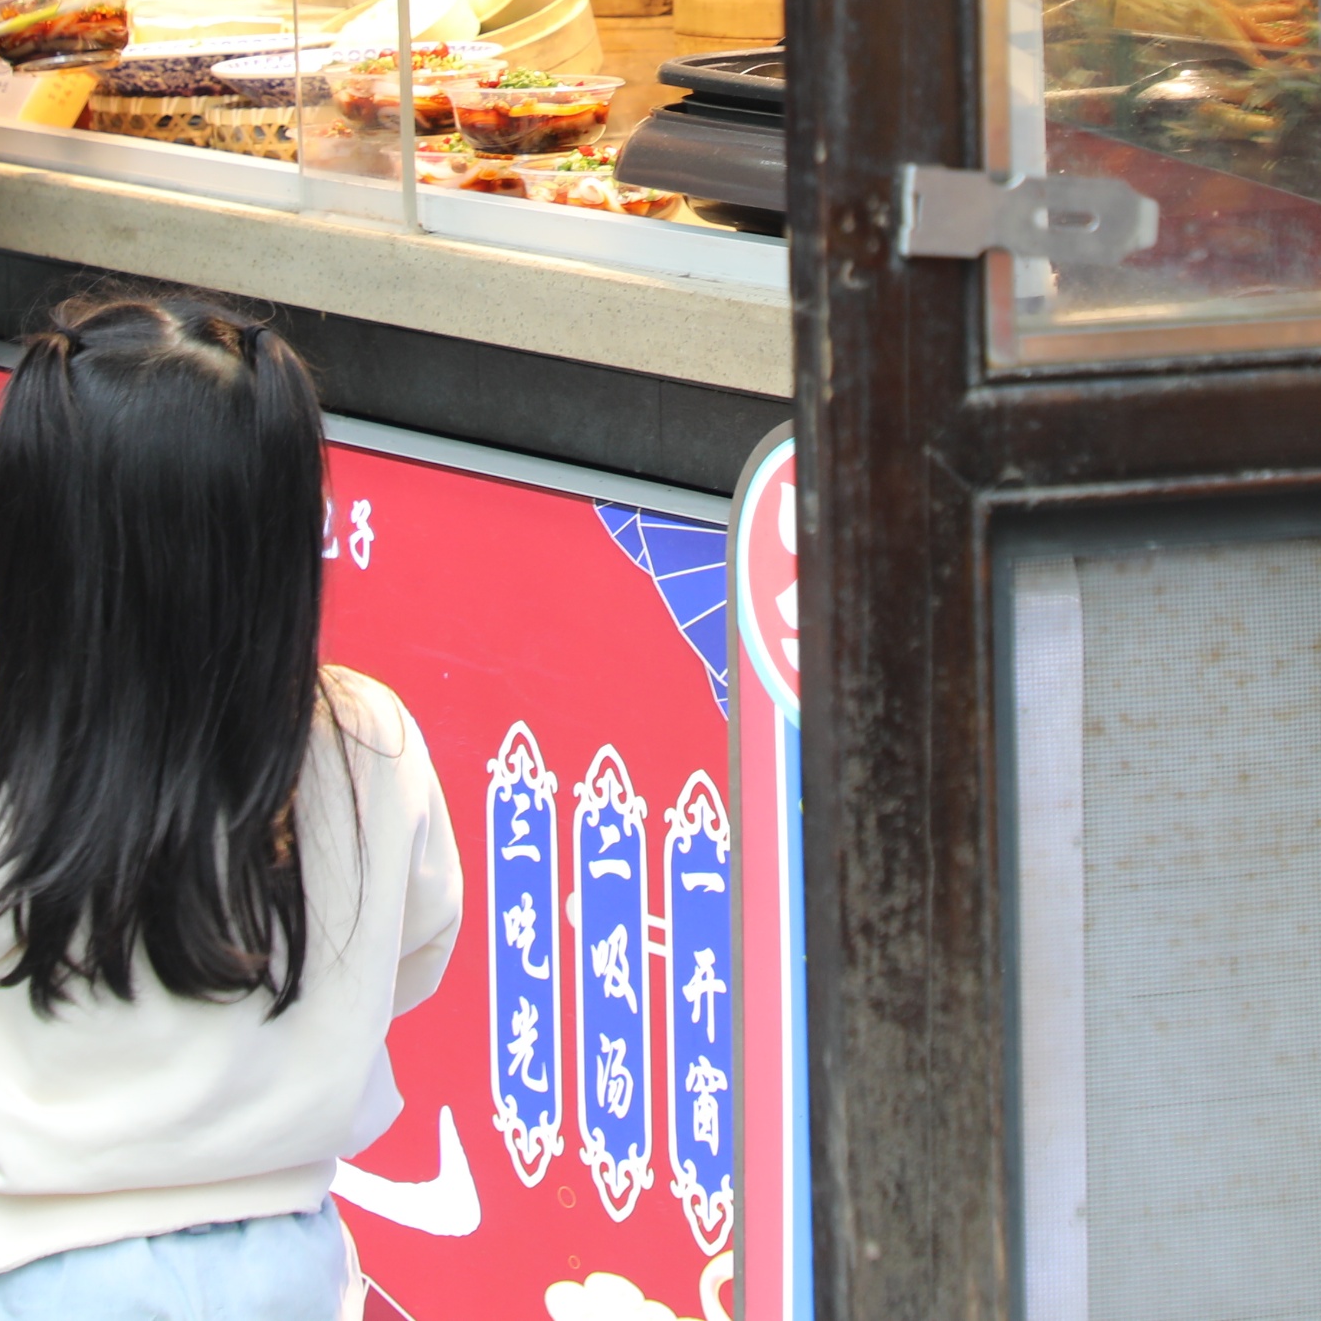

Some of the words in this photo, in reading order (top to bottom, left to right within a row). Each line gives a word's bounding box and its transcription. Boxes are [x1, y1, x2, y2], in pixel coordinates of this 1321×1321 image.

[501, 792, 551, 1094] 三吃光
[588, 823, 638, 1120] 二吸汤
[681, 870, 728, 1157] 一开窗
